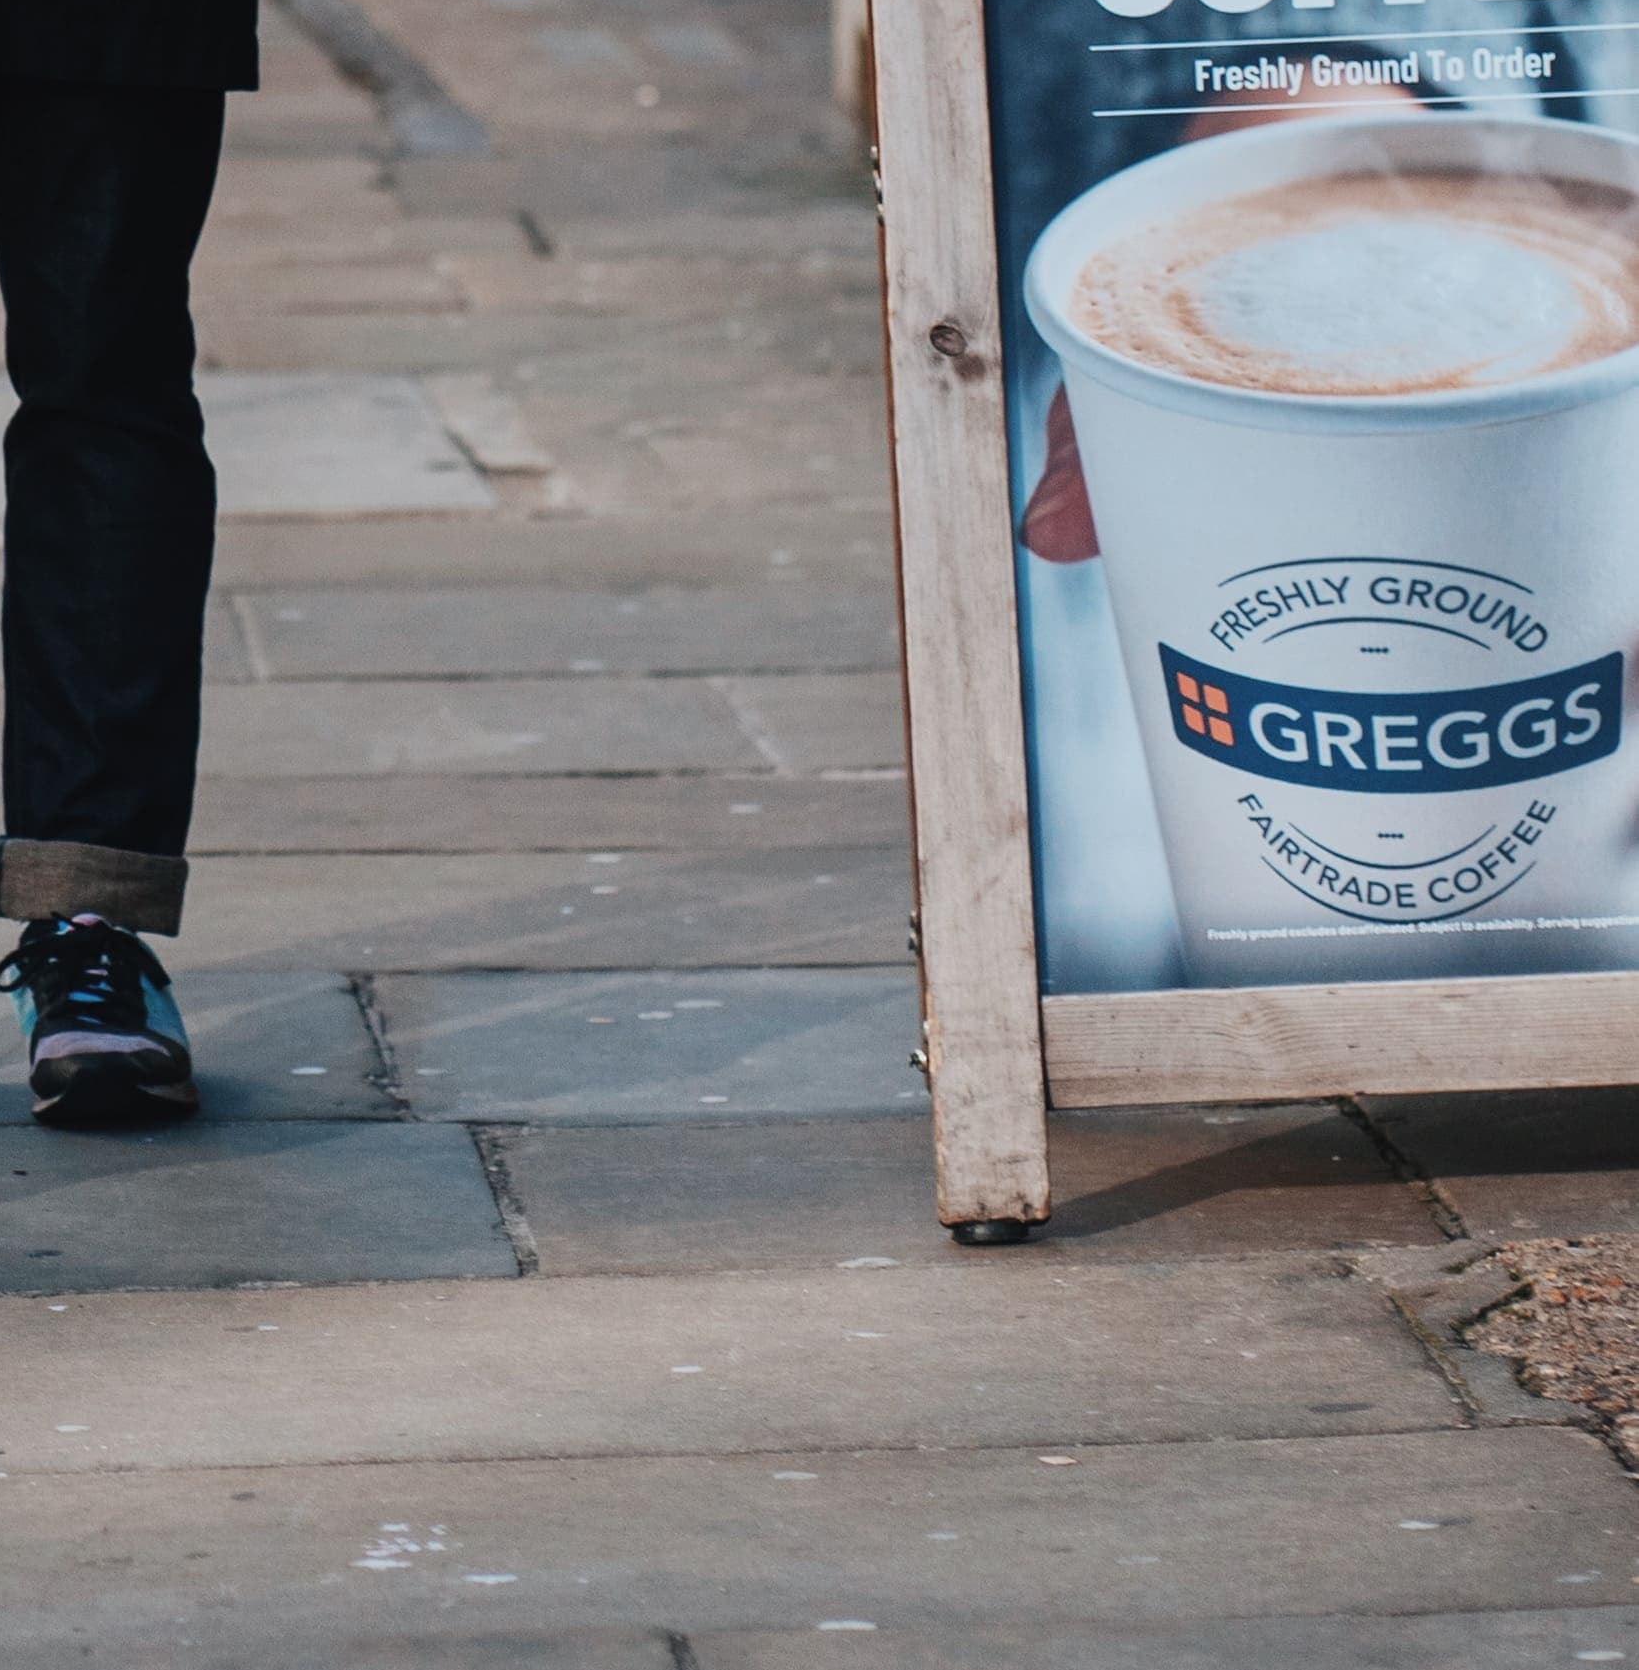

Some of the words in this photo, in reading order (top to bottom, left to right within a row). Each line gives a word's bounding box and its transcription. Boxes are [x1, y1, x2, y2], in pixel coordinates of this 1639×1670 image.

[1194, 56, 1305, 97] Freshly
[1312, 52, 1420, 89] Ground
[1426, 49, 1464, 82] To
[1473, 47, 1556, 81] Order
[1210, 575, 1351, 652] FRESHLY
[1369, 576, 1549, 653] GROUND
[1248, 682, 1602, 771] GREGGS
[1237, 793, 1417, 909] FAIRTRADE
[1427, 799, 1557, 903] COFFEE
